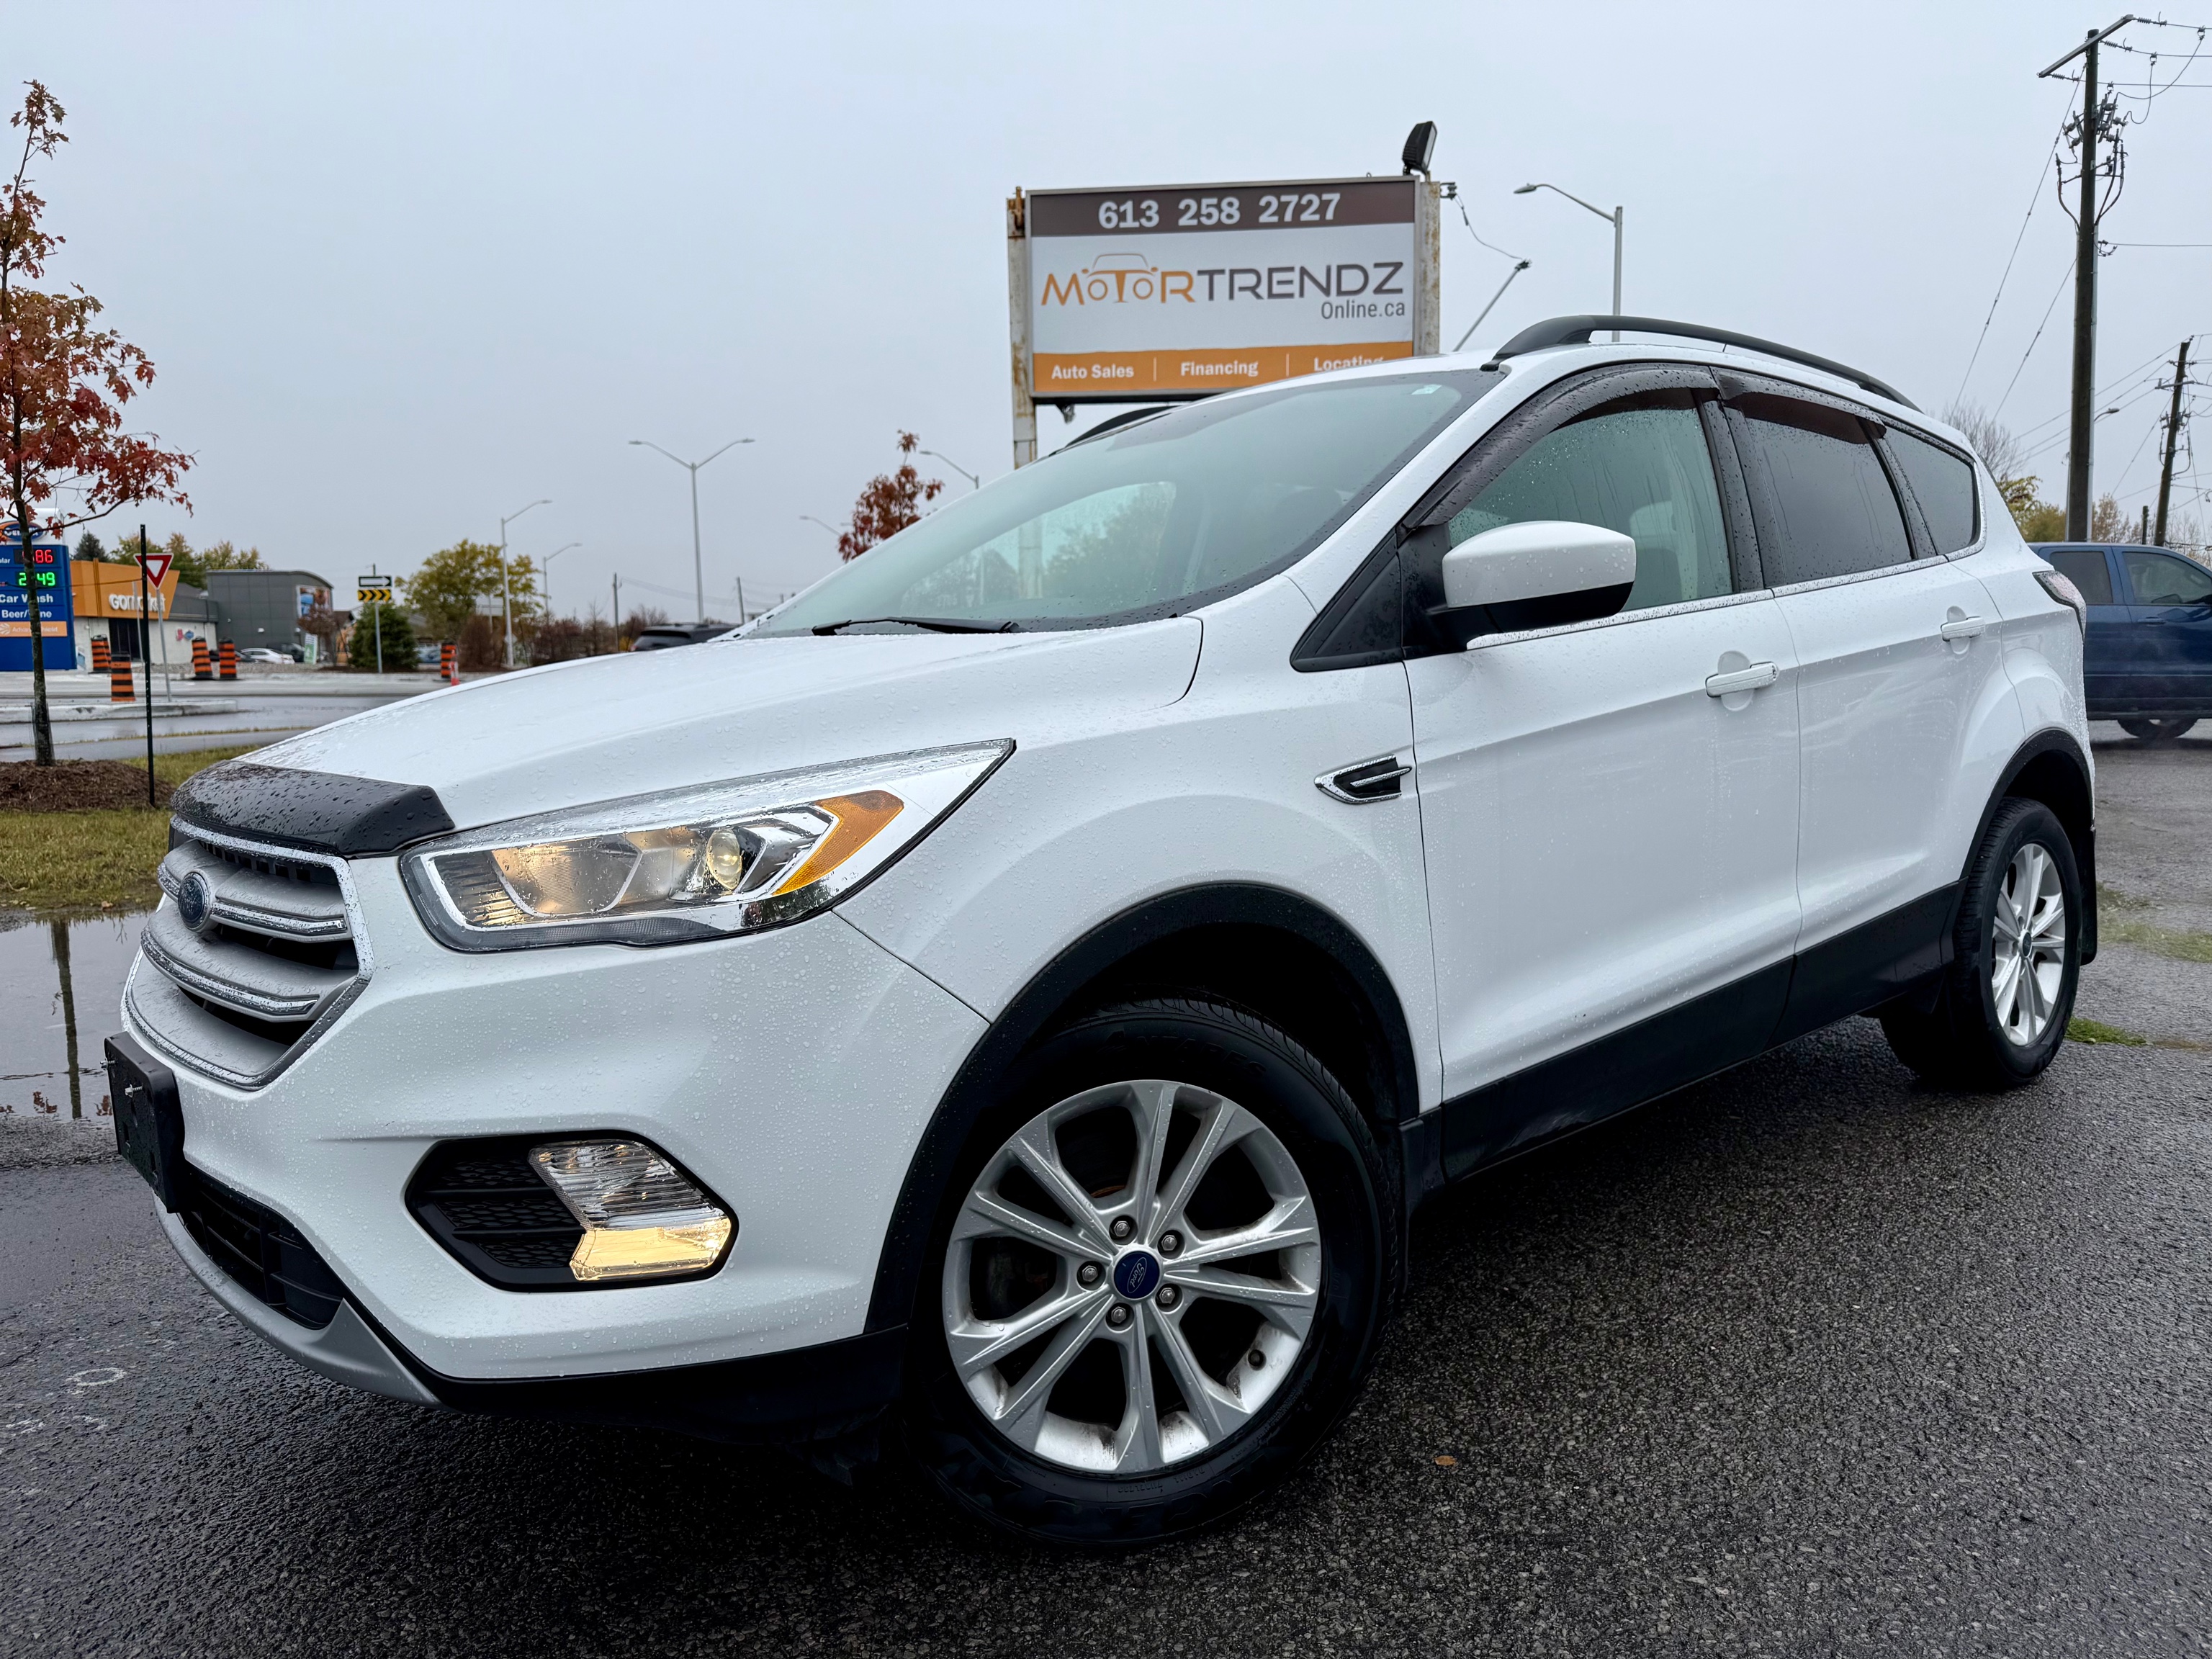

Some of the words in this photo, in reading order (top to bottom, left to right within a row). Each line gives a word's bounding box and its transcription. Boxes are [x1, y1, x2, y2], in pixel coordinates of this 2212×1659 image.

[1098, 200, 1159, 229] 613
[1178, 197, 1241, 226] 258
[1259, 193, 1341, 223] 2727
[1321, 300, 1406, 320] Online.ca
[1051, 364, 1087, 380] Auto
[1091, 363, 1135, 379] Sales
[1180, 360, 1259, 377] Financing
[1313, 354, 1384, 372] Locatin
[0, 593, 19, 603] Car
[1130, 1262, 1145, 1288] Ford
